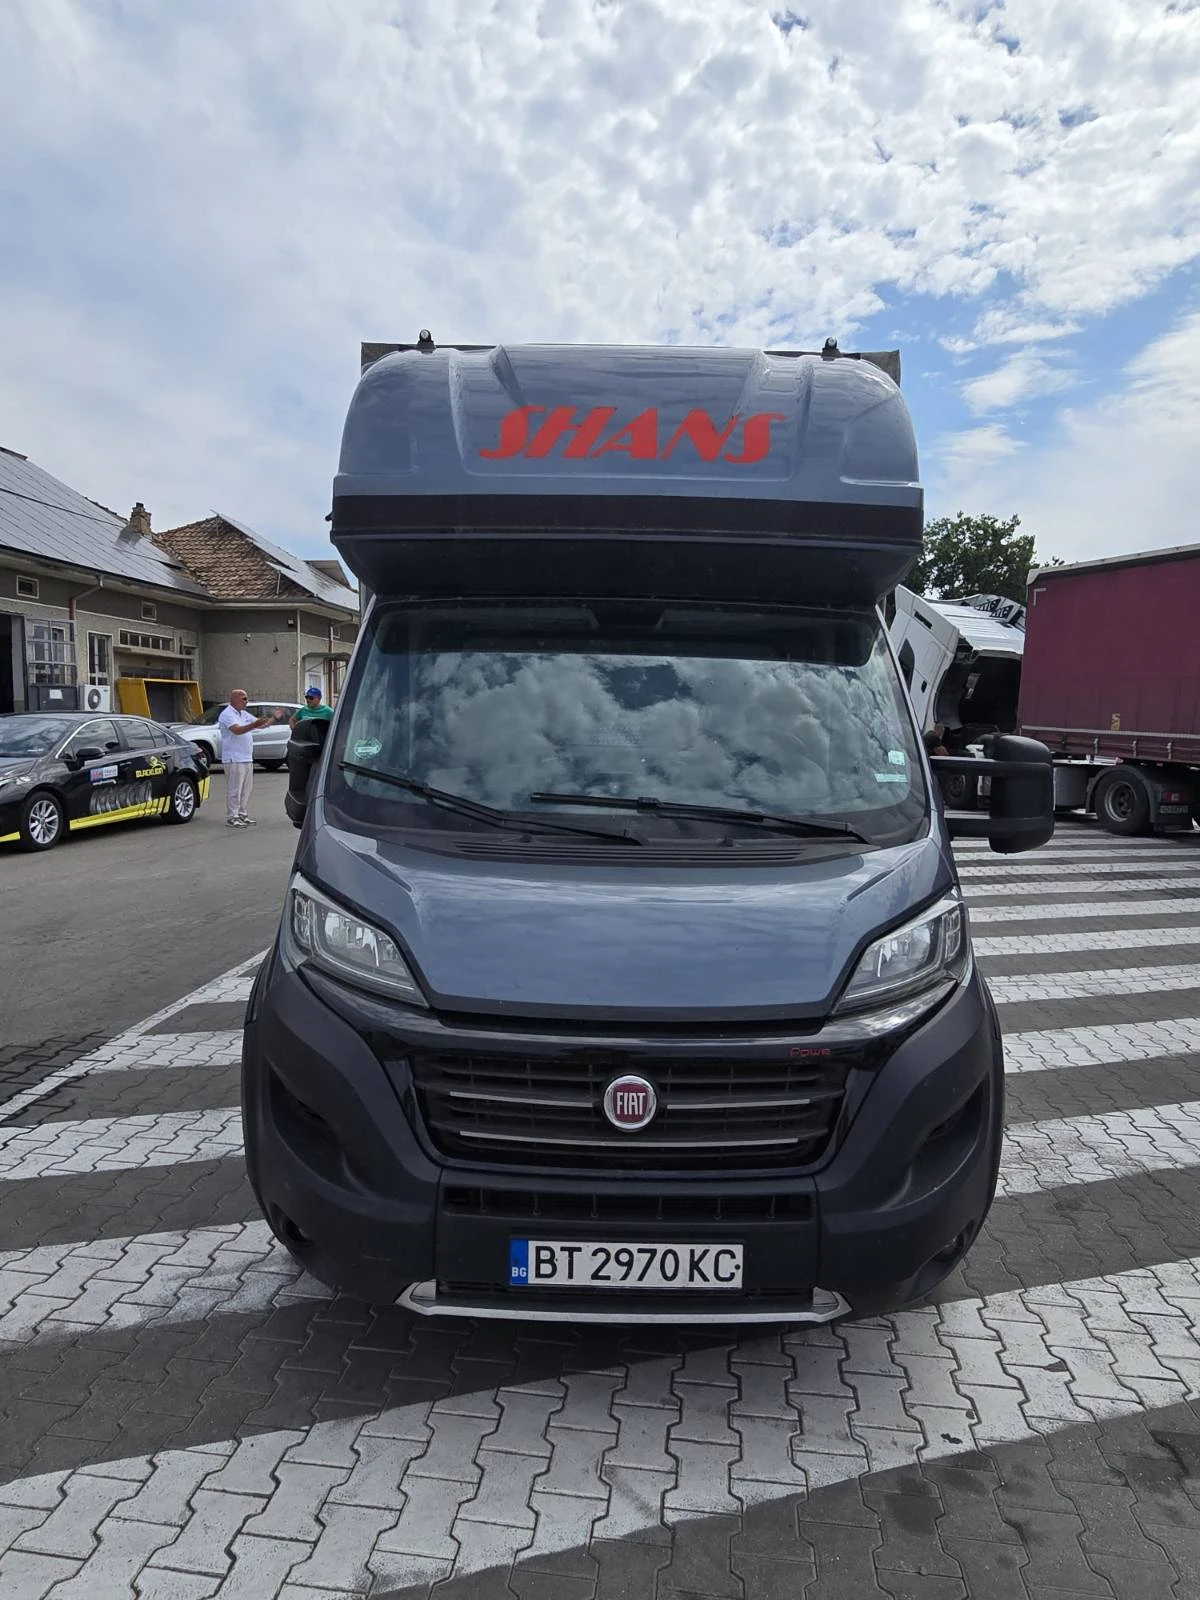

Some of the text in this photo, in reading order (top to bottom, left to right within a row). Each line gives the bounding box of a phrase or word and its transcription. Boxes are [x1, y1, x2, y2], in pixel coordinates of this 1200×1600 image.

[480, 406, 787, 464] SHANS
[616, 1091, 646, 1116] FIAT
[511, 1267, 527, 1277] BG
[535, 1246, 737, 1283] BT 2970 KC
